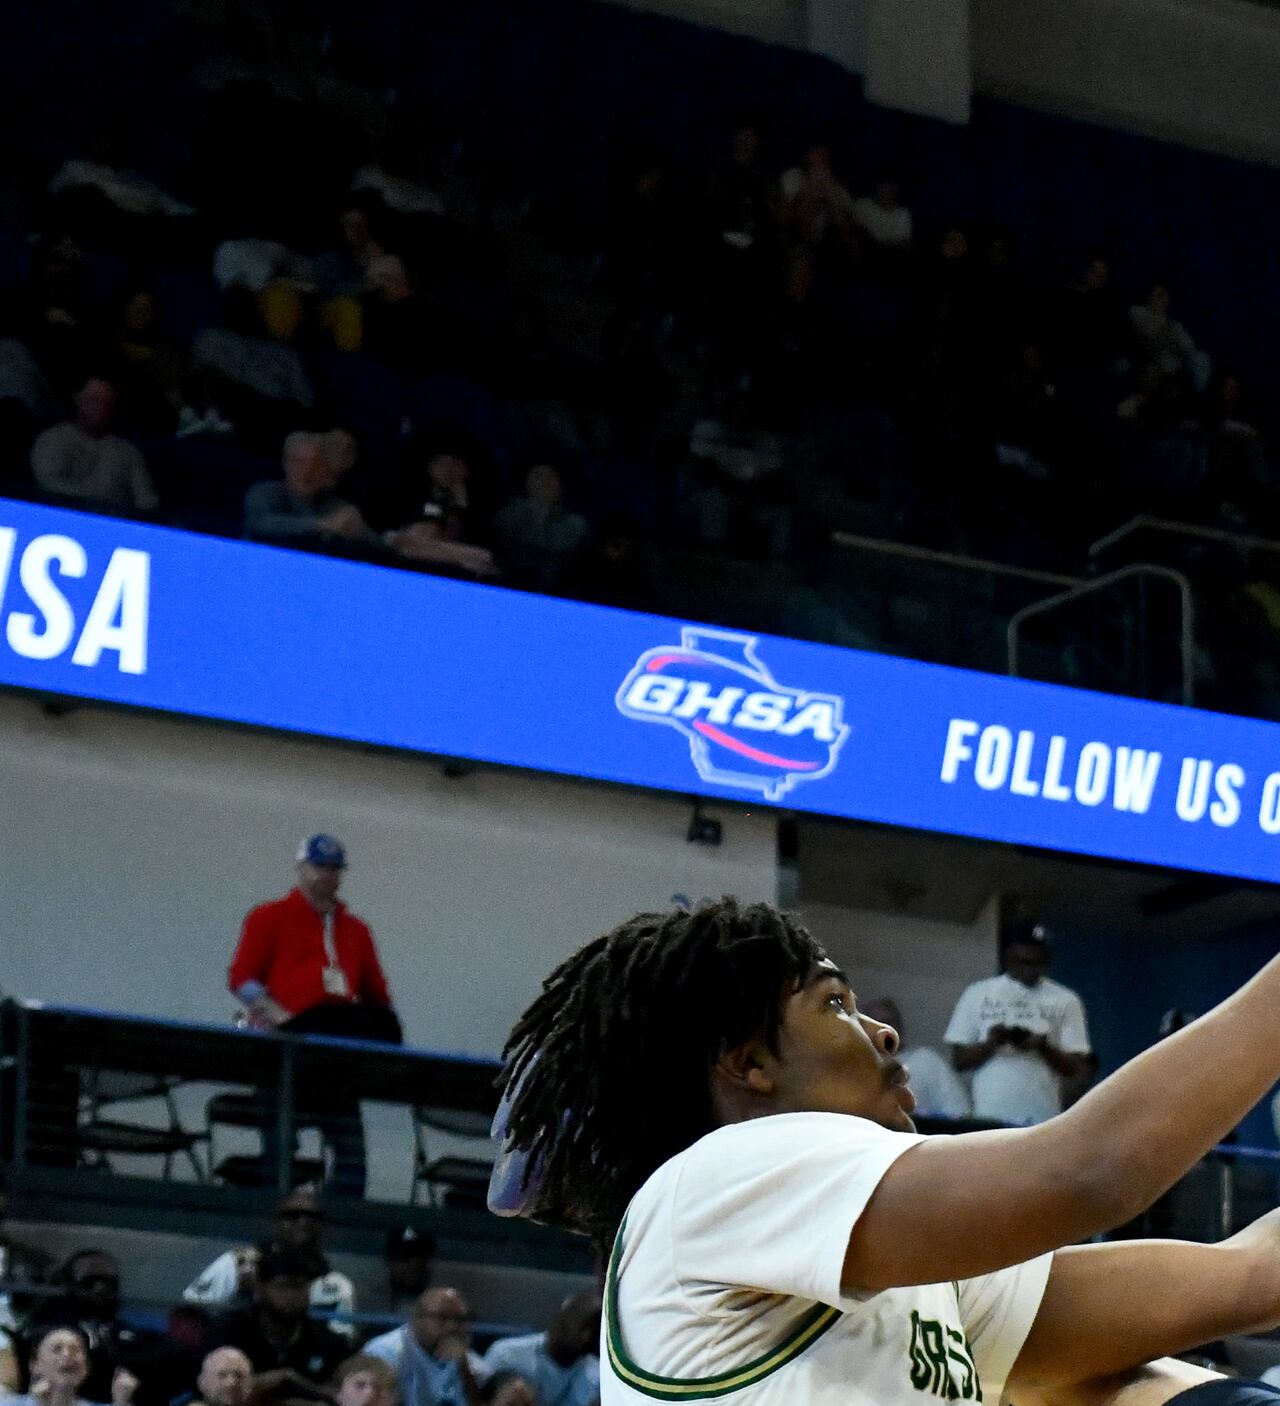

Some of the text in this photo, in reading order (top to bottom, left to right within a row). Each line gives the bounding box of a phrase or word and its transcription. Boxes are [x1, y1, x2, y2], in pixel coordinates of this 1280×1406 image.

[0, 528, 149, 674] SA
[623, 673, 837, 742] GHSA
[940, 719, 1161, 813] FOLLOW
[1176, 757, 1245, 827] US
